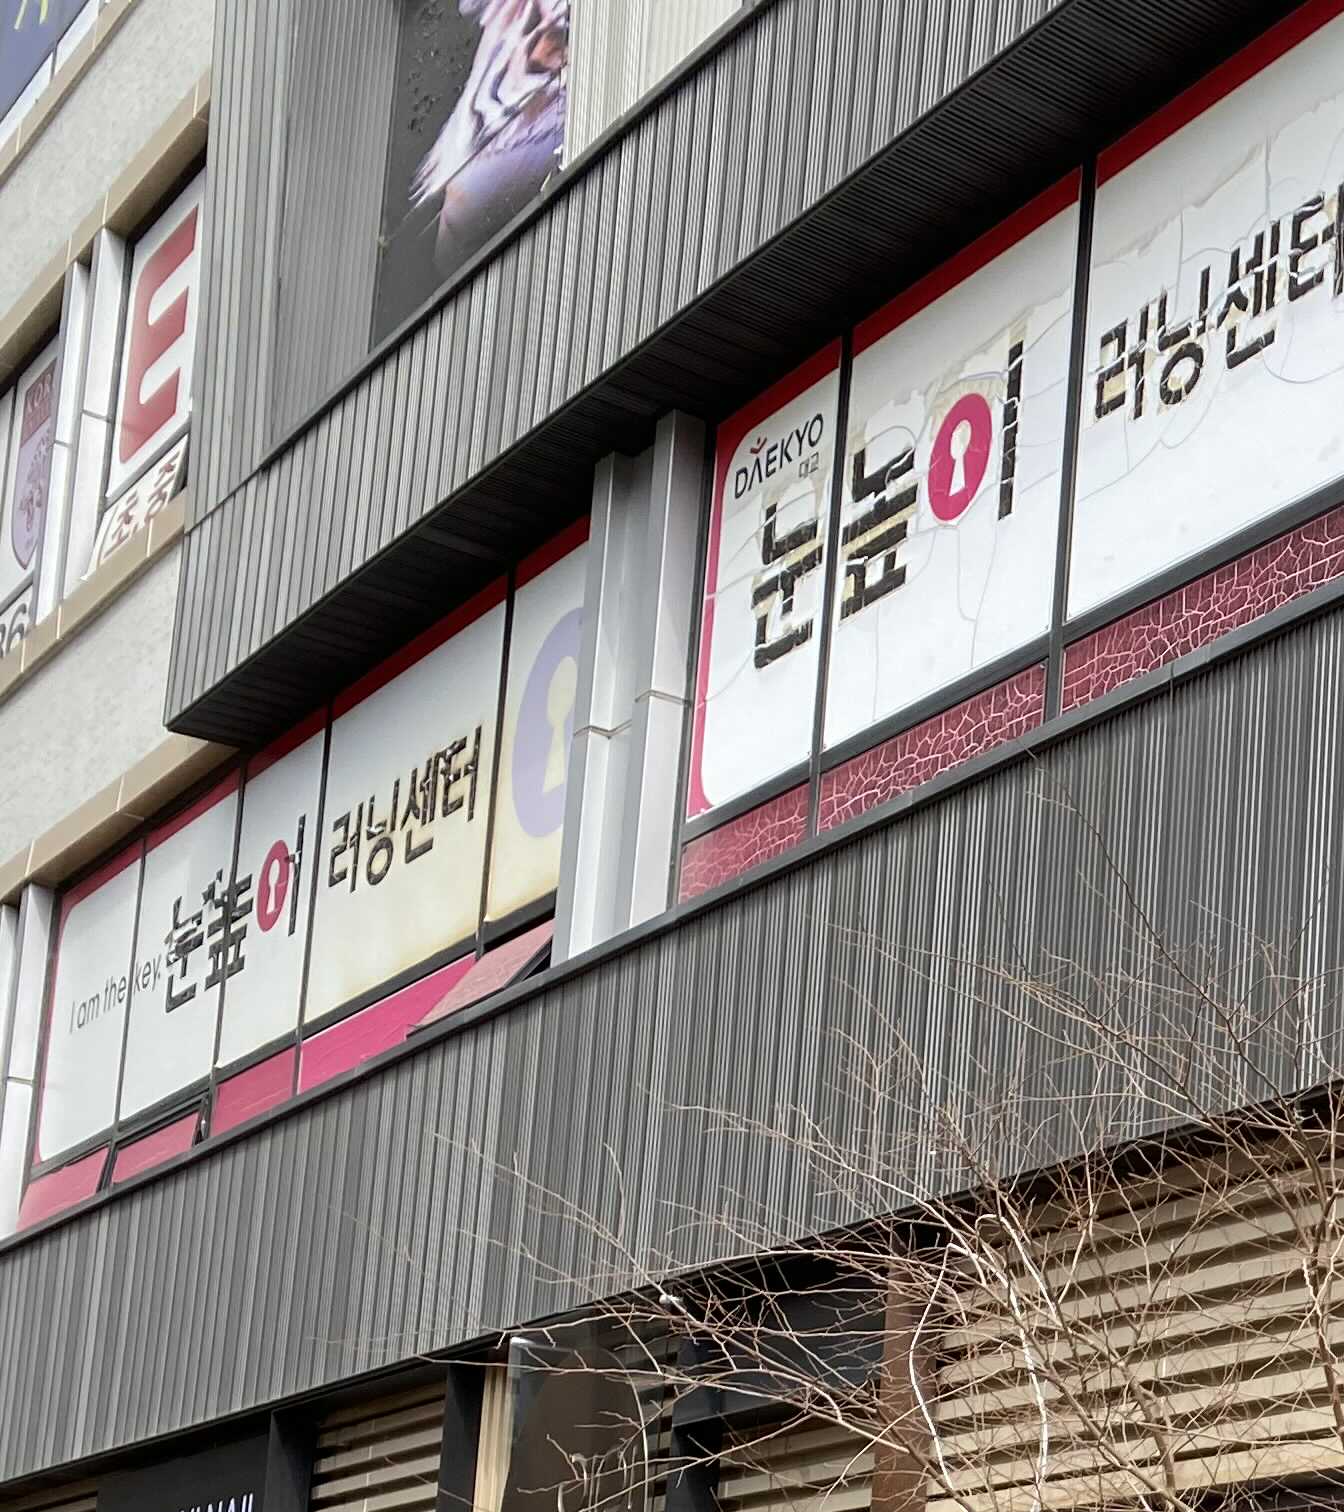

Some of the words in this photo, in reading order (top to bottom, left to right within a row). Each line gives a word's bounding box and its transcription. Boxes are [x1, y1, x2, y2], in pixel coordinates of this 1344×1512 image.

[735, 413, 824, 499] DAEKYO
[328, 724, 482, 893] 러닝센터
[77, 991, 100, 1029] am
[103, 975, 127, 1013] the
